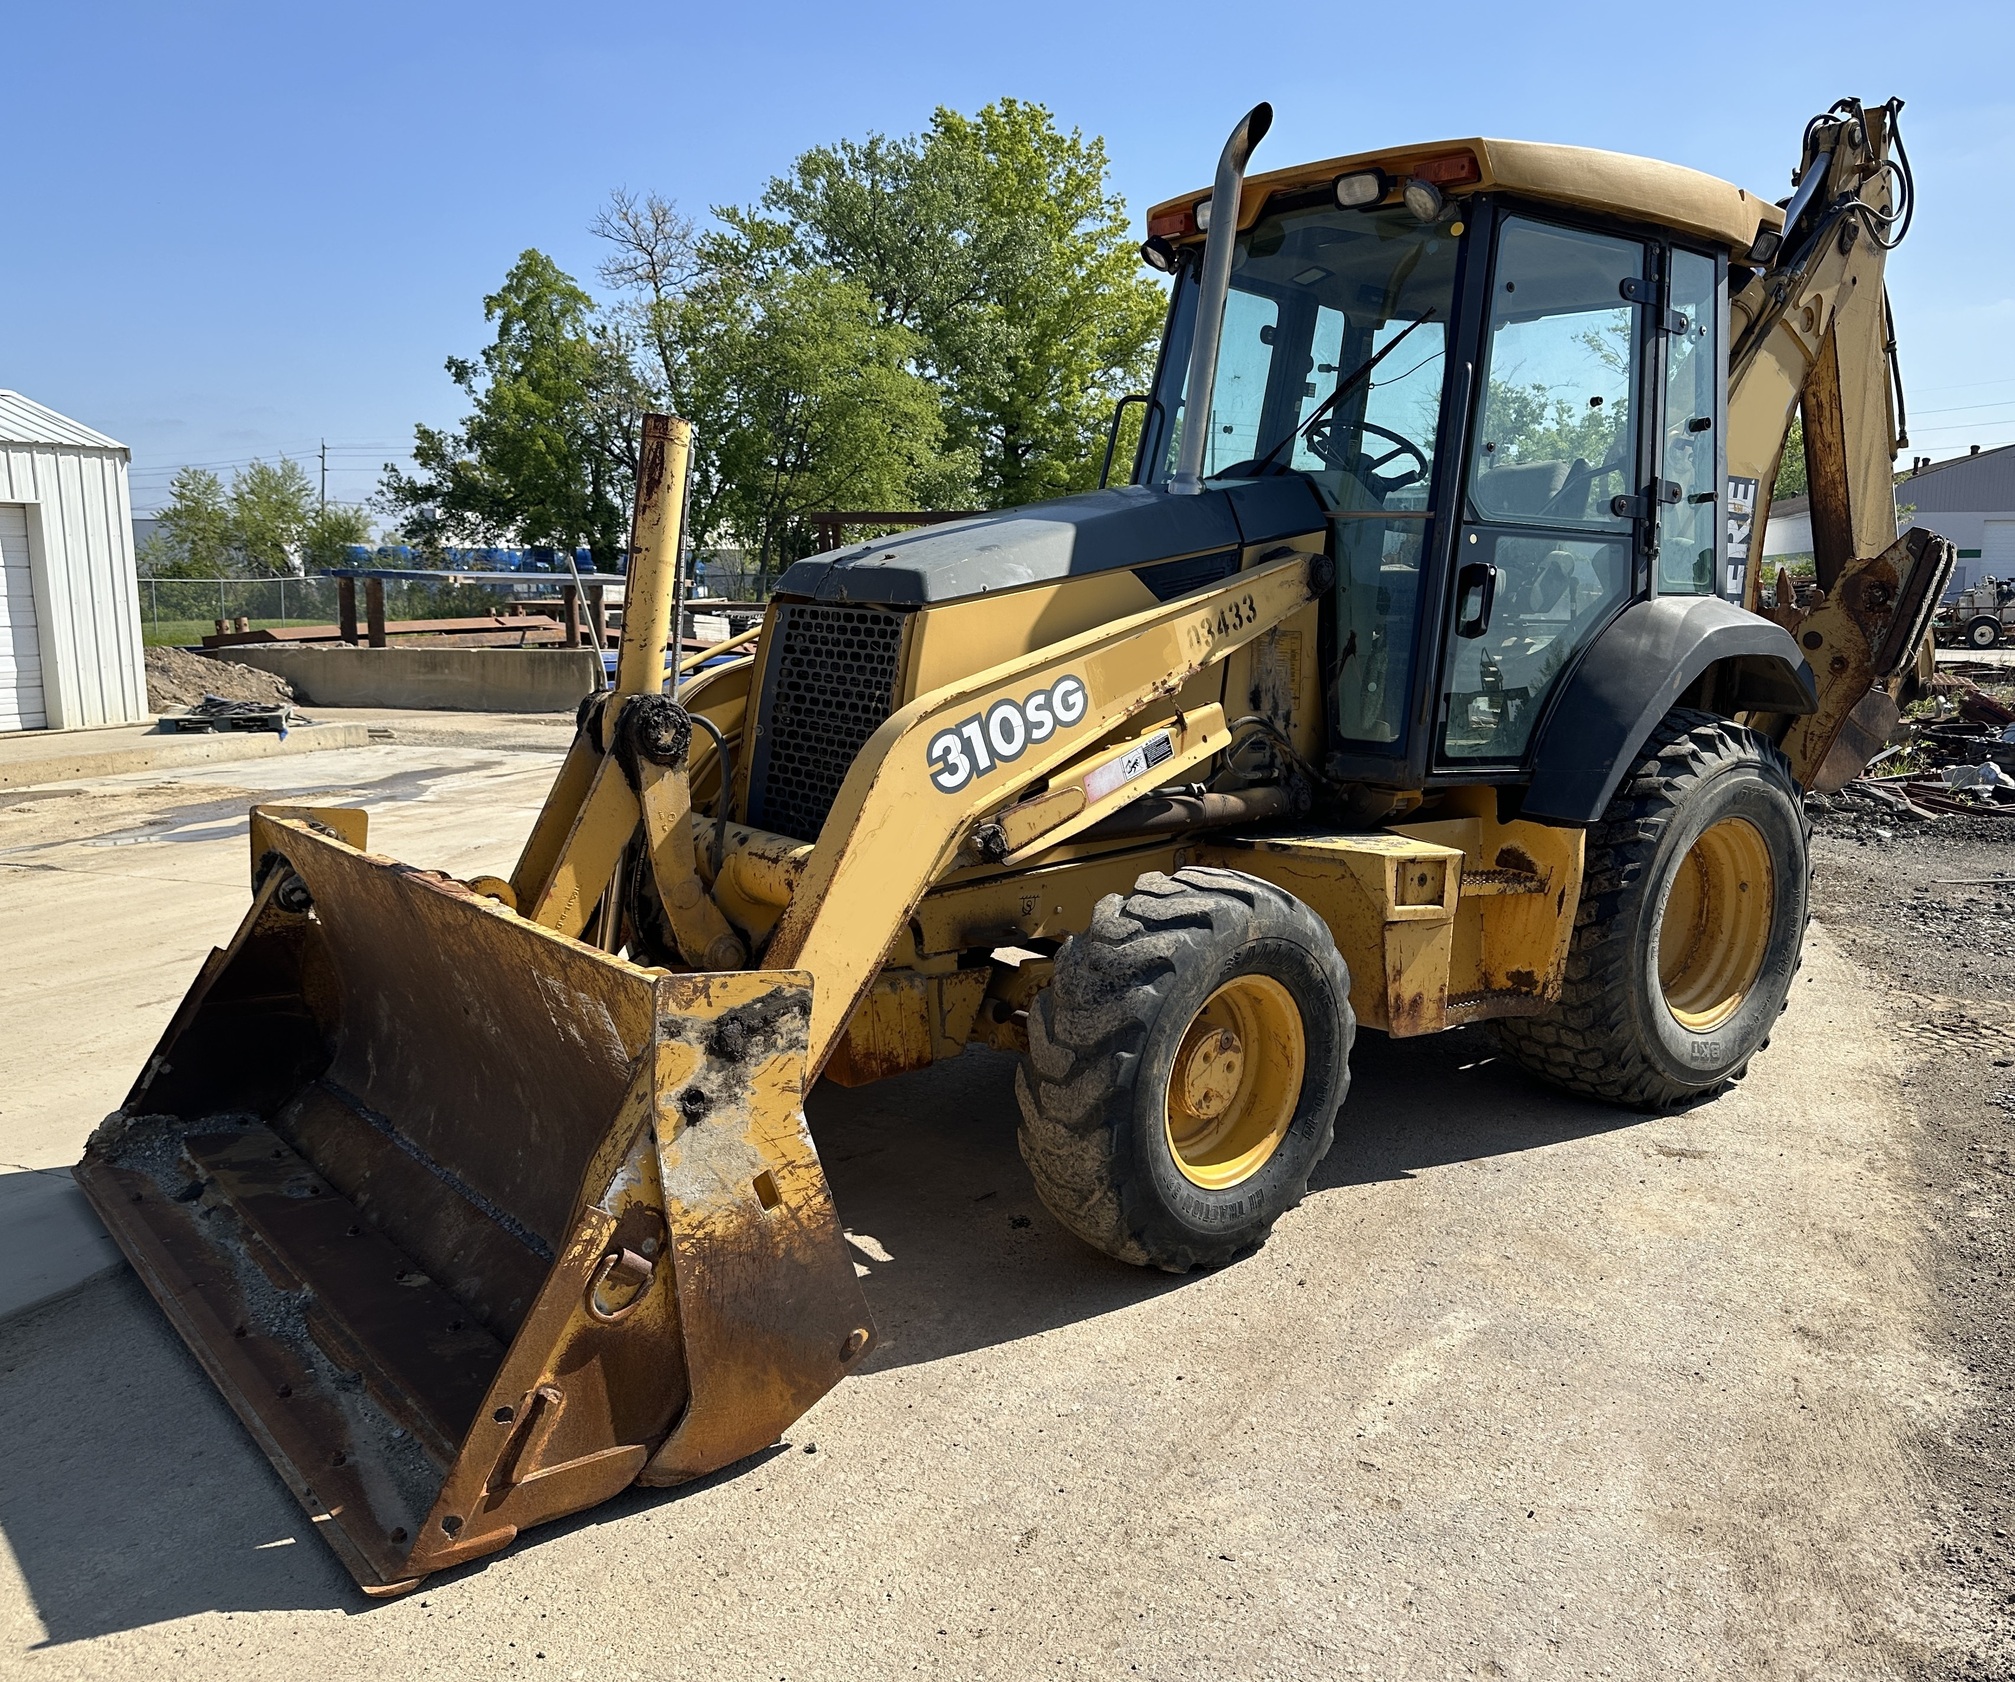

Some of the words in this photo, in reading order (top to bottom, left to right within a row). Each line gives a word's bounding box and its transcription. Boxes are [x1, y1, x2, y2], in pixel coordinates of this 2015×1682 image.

[1727, 481, 1756, 608] ERE
[1187, 593, 1257, 649] 03433
[927, 675, 1089, 794] 310SG
[1241, 941, 1333, 1016] ALLIANCE
[1690, 1040, 1720, 1061] BKT
[1181, 1193, 1247, 1224] TRACTION
